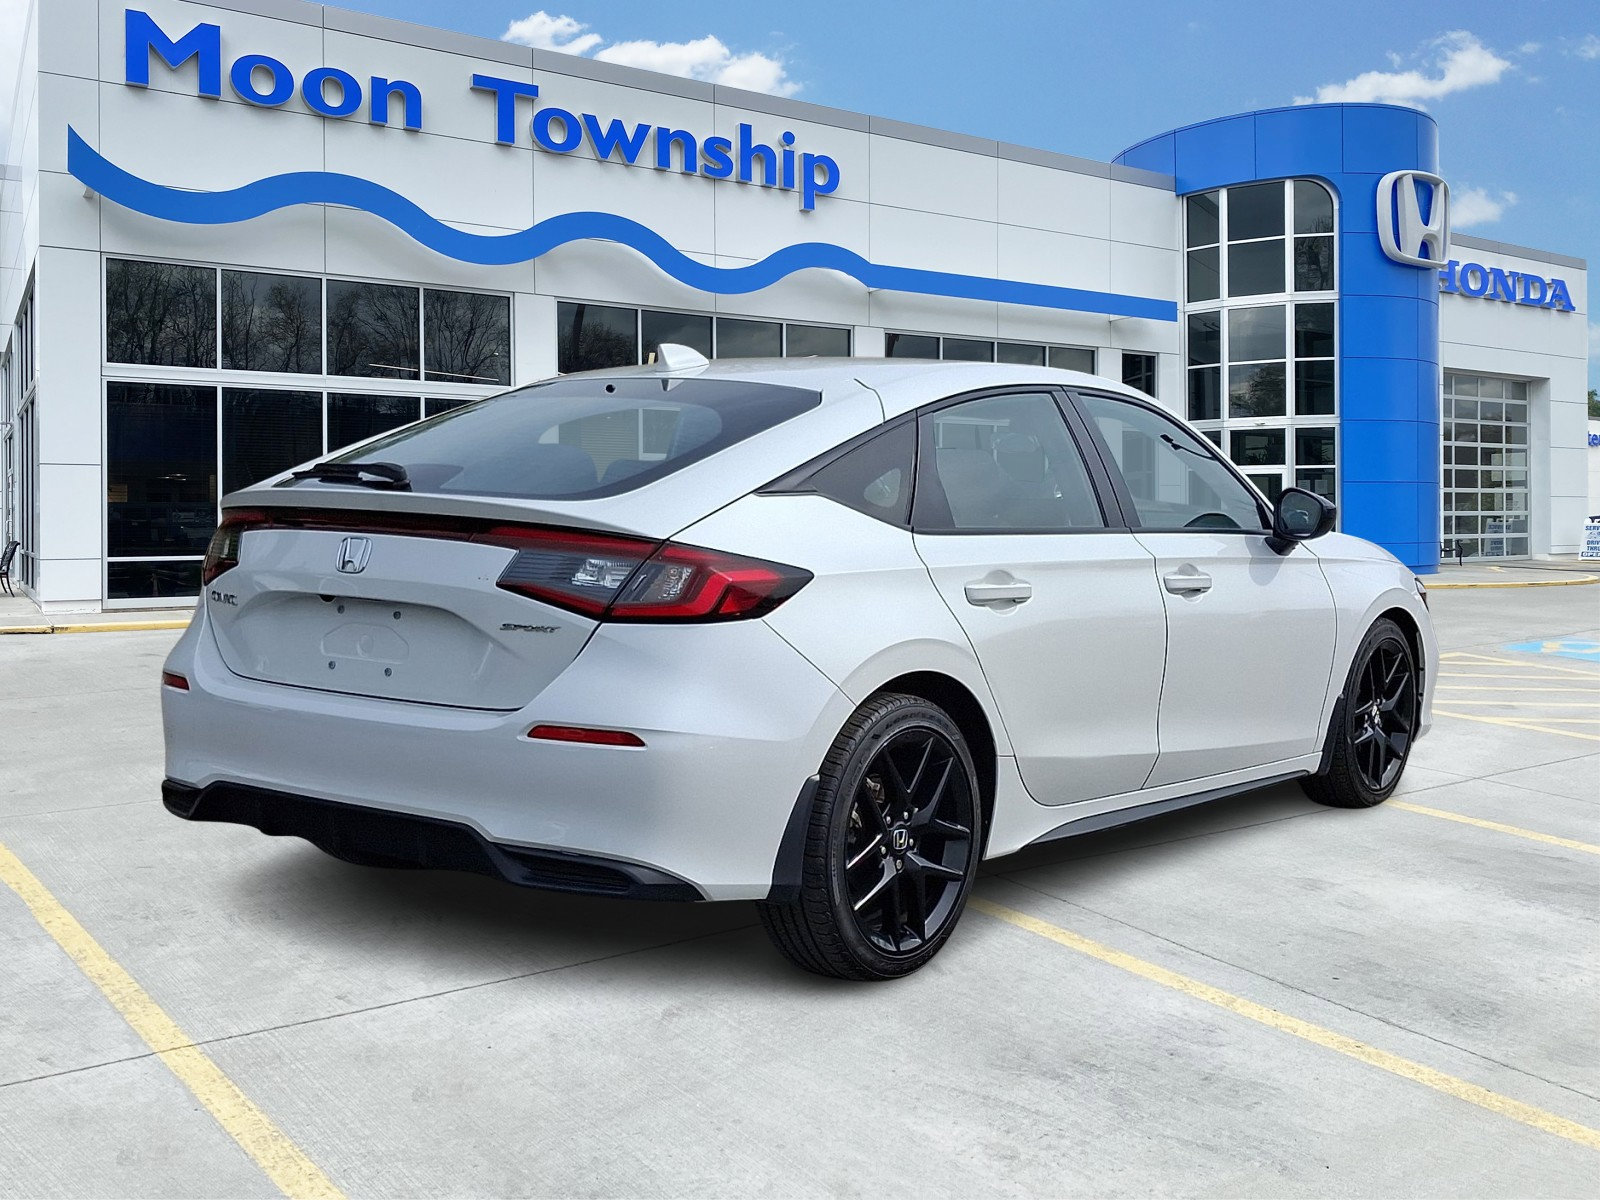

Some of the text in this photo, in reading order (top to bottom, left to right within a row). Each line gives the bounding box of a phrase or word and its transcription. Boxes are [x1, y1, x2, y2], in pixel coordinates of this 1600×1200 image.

[124, 8, 842, 212] Moon Township
[1438, 259, 1576, 312] HONDA
